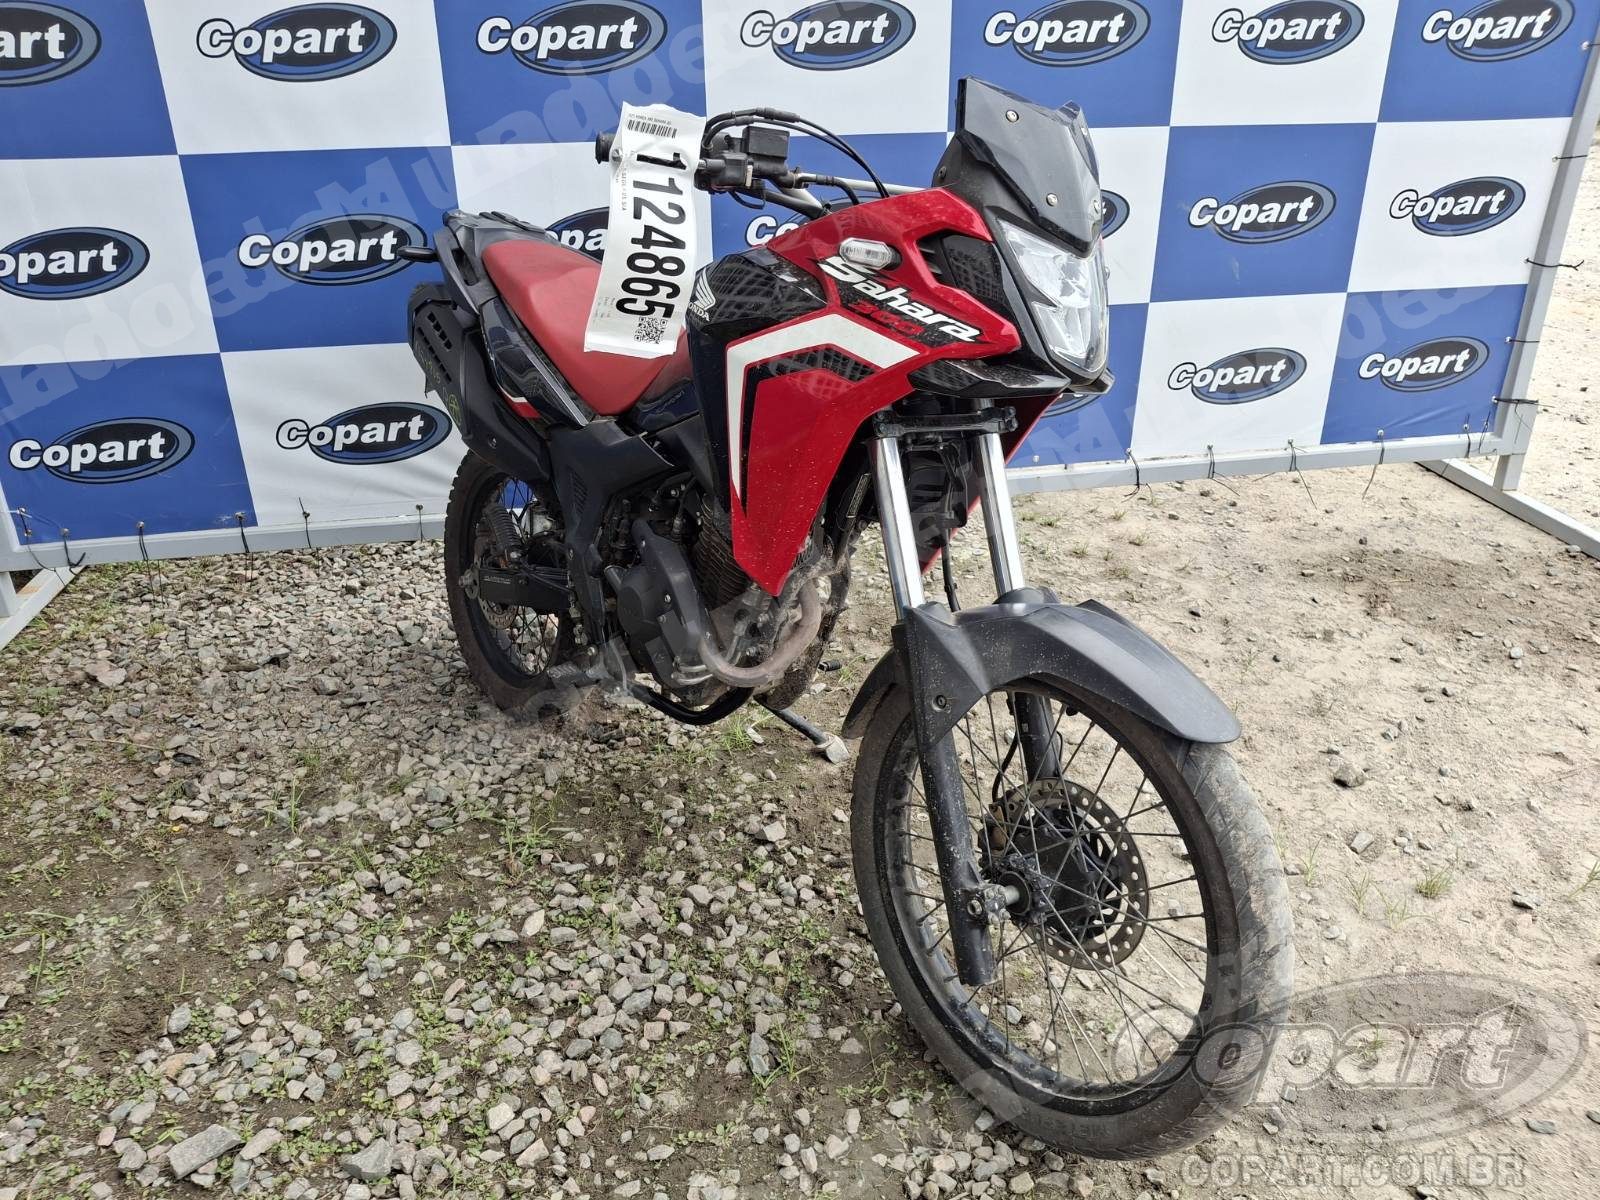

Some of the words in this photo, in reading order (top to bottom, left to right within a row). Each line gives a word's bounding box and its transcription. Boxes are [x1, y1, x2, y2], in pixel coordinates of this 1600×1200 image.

[198, 18, 366, 63] Copart
[477, 16, 638, 60] Copart
[741, 10, 889, 52] Copart
[986, 11, 1125, 52] Copart
[1213, 8, 1343, 47] Copart
[1422, 6, 1552, 47] Copart
[1189, 195, 1314, 231] Copart
[1390, 188, 1506, 222] Copart
[239, 230, 398, 272] Copart
[615, 151, 687, 320] 1124865
[687, 302, 711, 322] ONDA
[817, 256, 981, 342] Sahara
[1169, 358, 1287, 392] Copart
[1359, 349, 1471, 382] Copart
[9, 431, 166, 473] Copart
[277, 414, 425, 452] Copart
